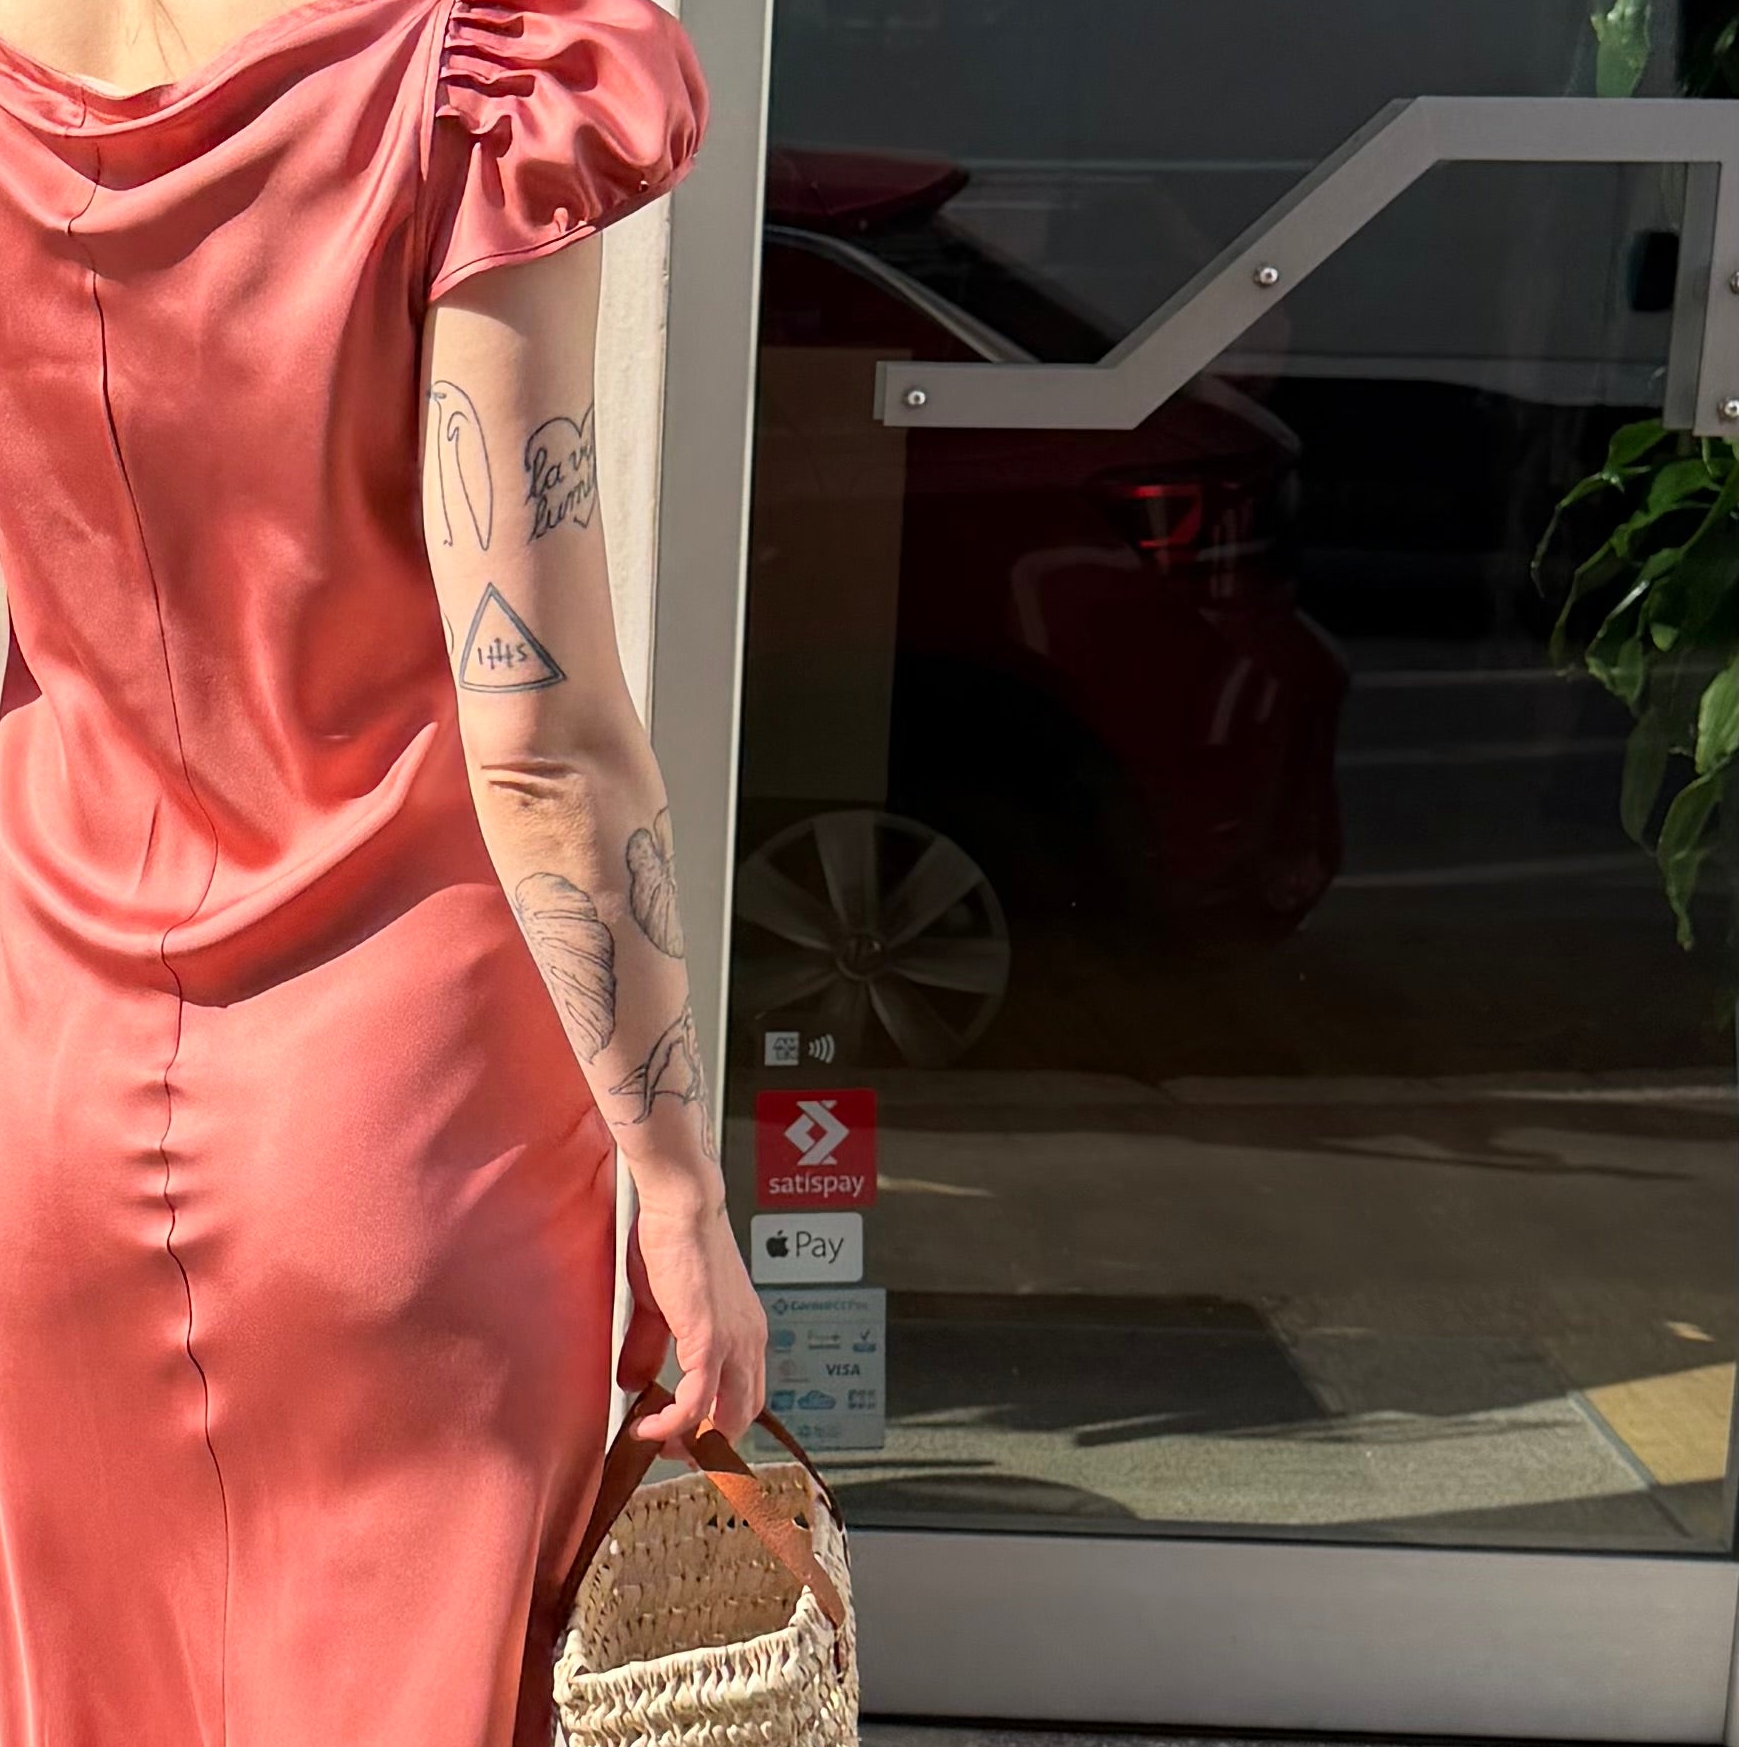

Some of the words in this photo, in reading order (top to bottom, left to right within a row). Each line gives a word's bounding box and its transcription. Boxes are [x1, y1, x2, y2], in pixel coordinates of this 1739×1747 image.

[768, 1173, 866, 1198] satispay
[795, 1231, 844, 1264] Pay
[826, 1363, 861, 1376] VISA
